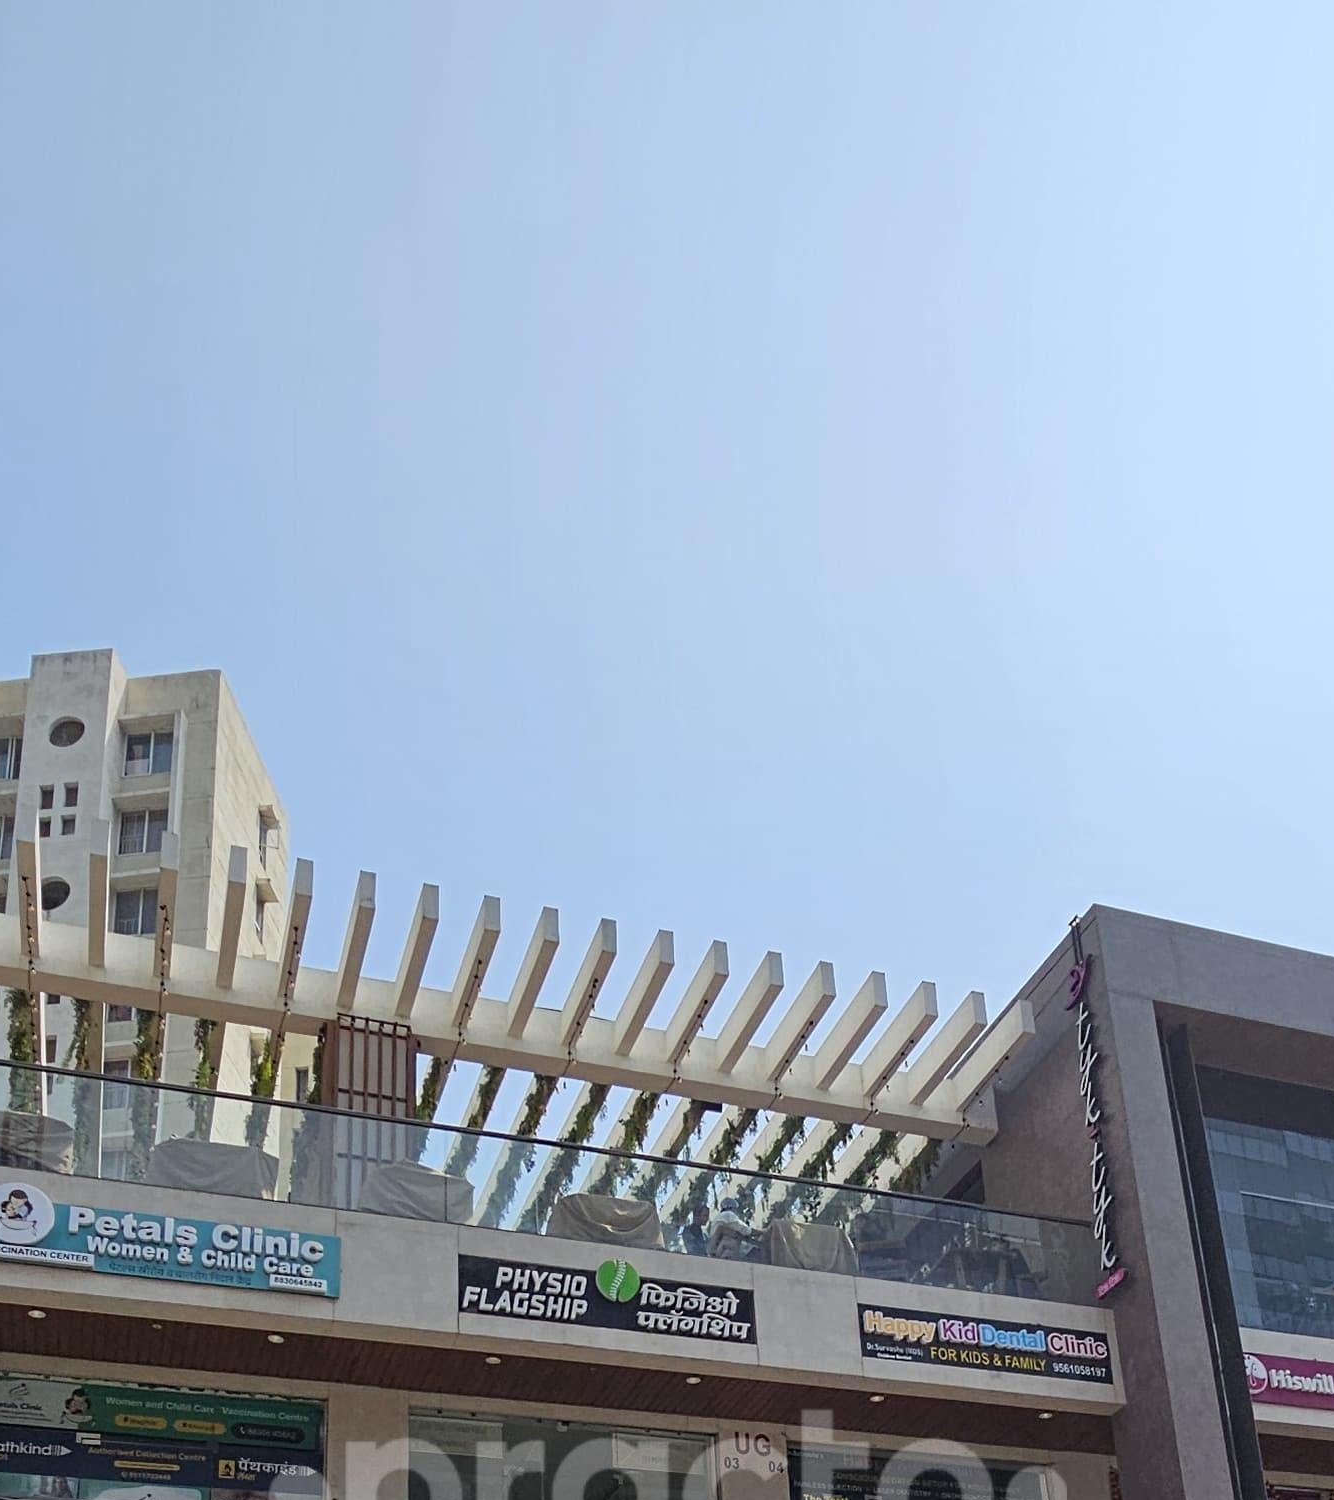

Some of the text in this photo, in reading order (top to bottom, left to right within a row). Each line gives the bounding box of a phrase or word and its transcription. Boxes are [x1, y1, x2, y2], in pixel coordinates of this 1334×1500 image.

[68, 1205, 324, 1263] Petals Clinic
[49, 1251, 89, 1263] CENTER
[86, 1236, 314, 1278] Women & Child Care
[495, 1266, 588, 1300] PHYSIO
[462, 1287, 588, 1321] FLAGSHIP
[863, 1310, 1108, 1359] Happy Kid Dental Clinic
[930, 1347, 1046, 1372] FOR KIDS & FAMILY
[734, 1431, 771, 1457] UG
[723, 1456, 785, 1474] 03 04
